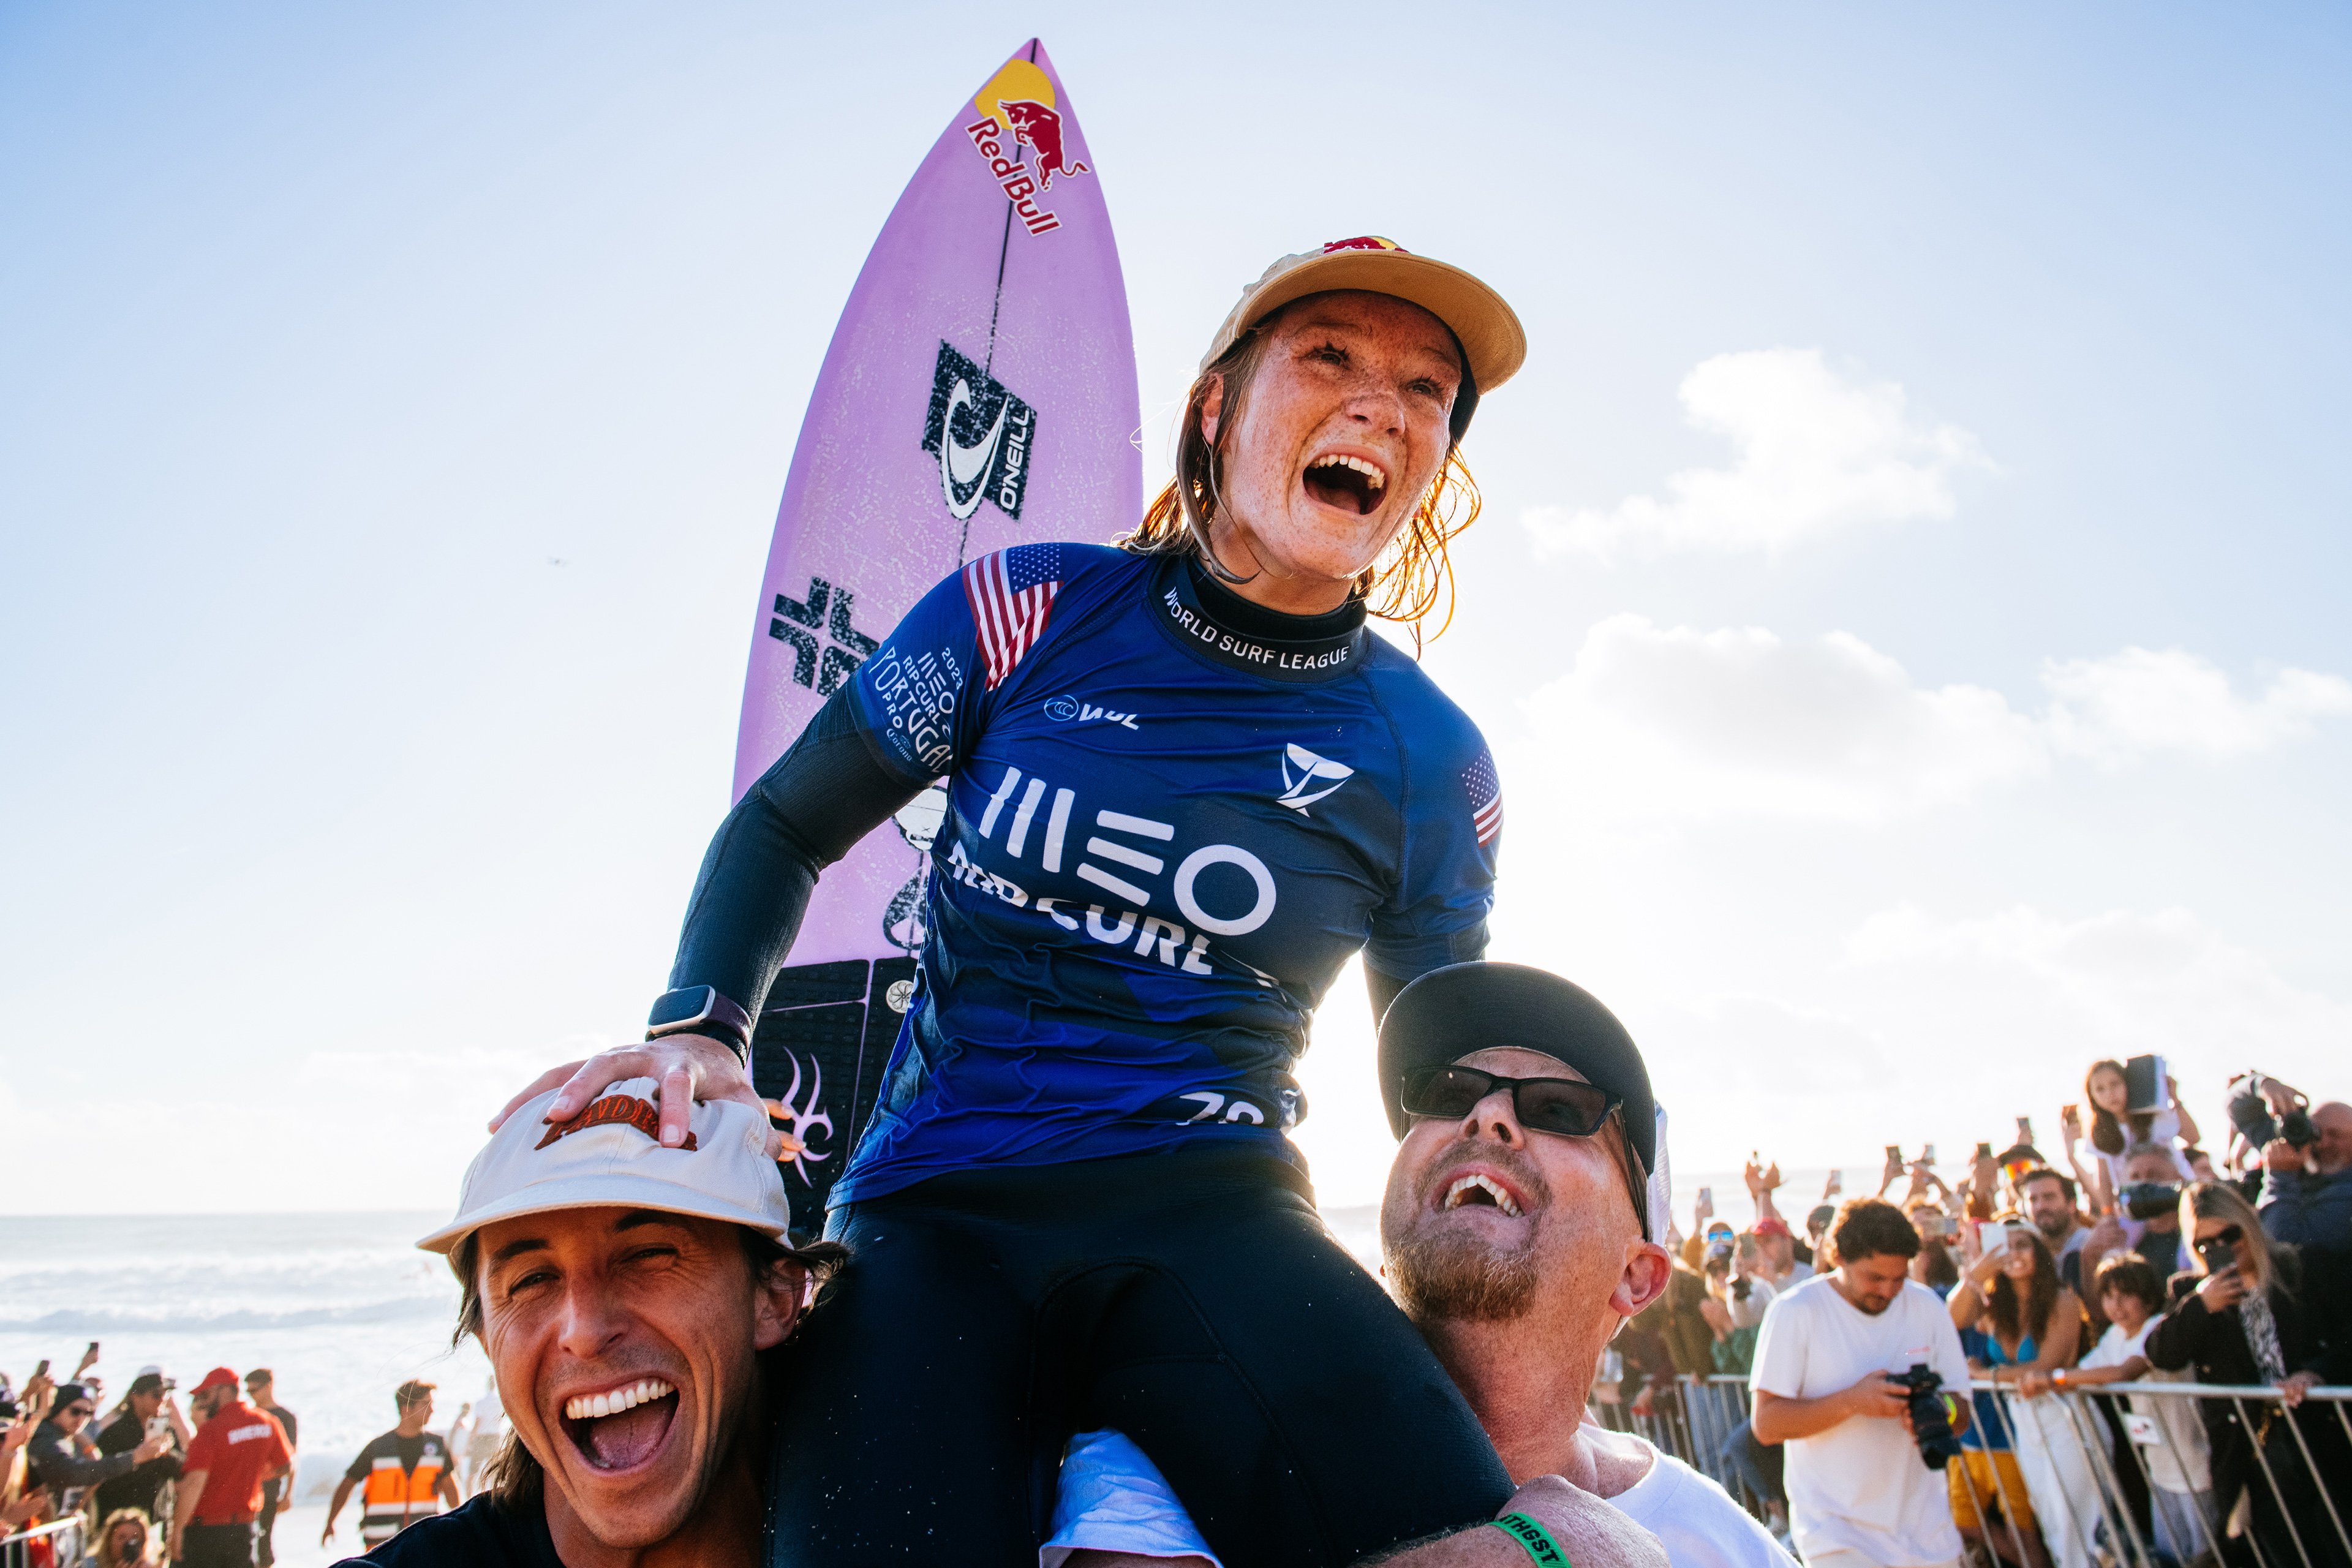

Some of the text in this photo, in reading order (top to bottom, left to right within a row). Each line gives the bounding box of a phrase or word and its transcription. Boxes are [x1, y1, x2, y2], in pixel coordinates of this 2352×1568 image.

[1000, 410, 1029, 510] O'NEILL
[1164, 586, 1349, 669] WORLD SURF LEAGUE
[903, 655, 940, 725] RIP CURL
[941, 647, 963, 690] 2023
[869, 646, 953, 772] PORTUGAL
[882, 692, 903, 728] PRO
